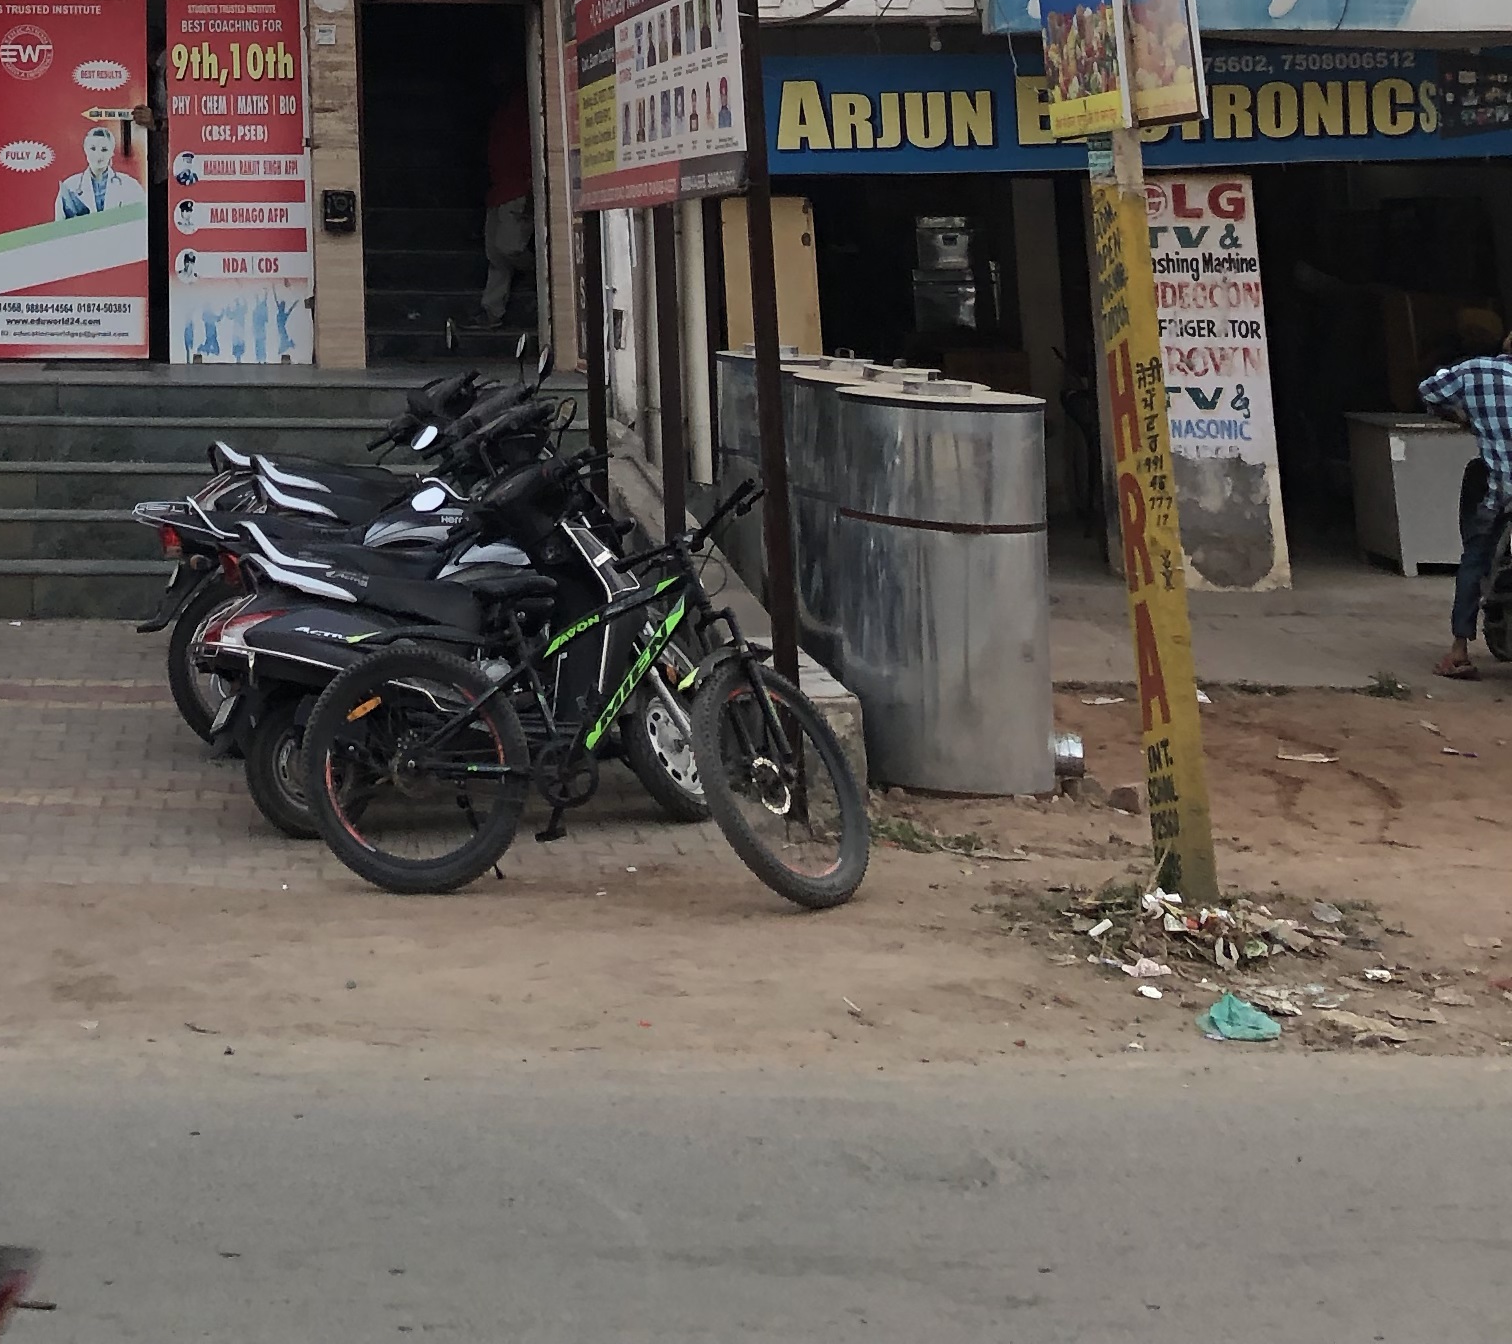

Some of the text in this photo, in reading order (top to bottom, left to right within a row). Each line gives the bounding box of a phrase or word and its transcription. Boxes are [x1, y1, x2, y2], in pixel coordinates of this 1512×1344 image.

[5, 4, 50, 15] TRUSTED
[52, 4, 102, 15] INSTITUTE
[181, 19, 283, 33] BEST COACHING FOR
[172, 95, 297, 115] PHY CHEM MATHS BIO
[776, 76, 1439, 151] ARJUN ERONICS
[5, 151, 47, 160] FULLY AC
[1171, 183, 1246, 221] LG
[209, 207, 289, 224] MAI BHAGO AFPI
[222, 257, 279, 274] NDA CDS
[1151, 251, 1257, 282] ashing Machine
[1170, 419, 1253, 441] NASONIC
[558, 614, 600, 648] AVON
